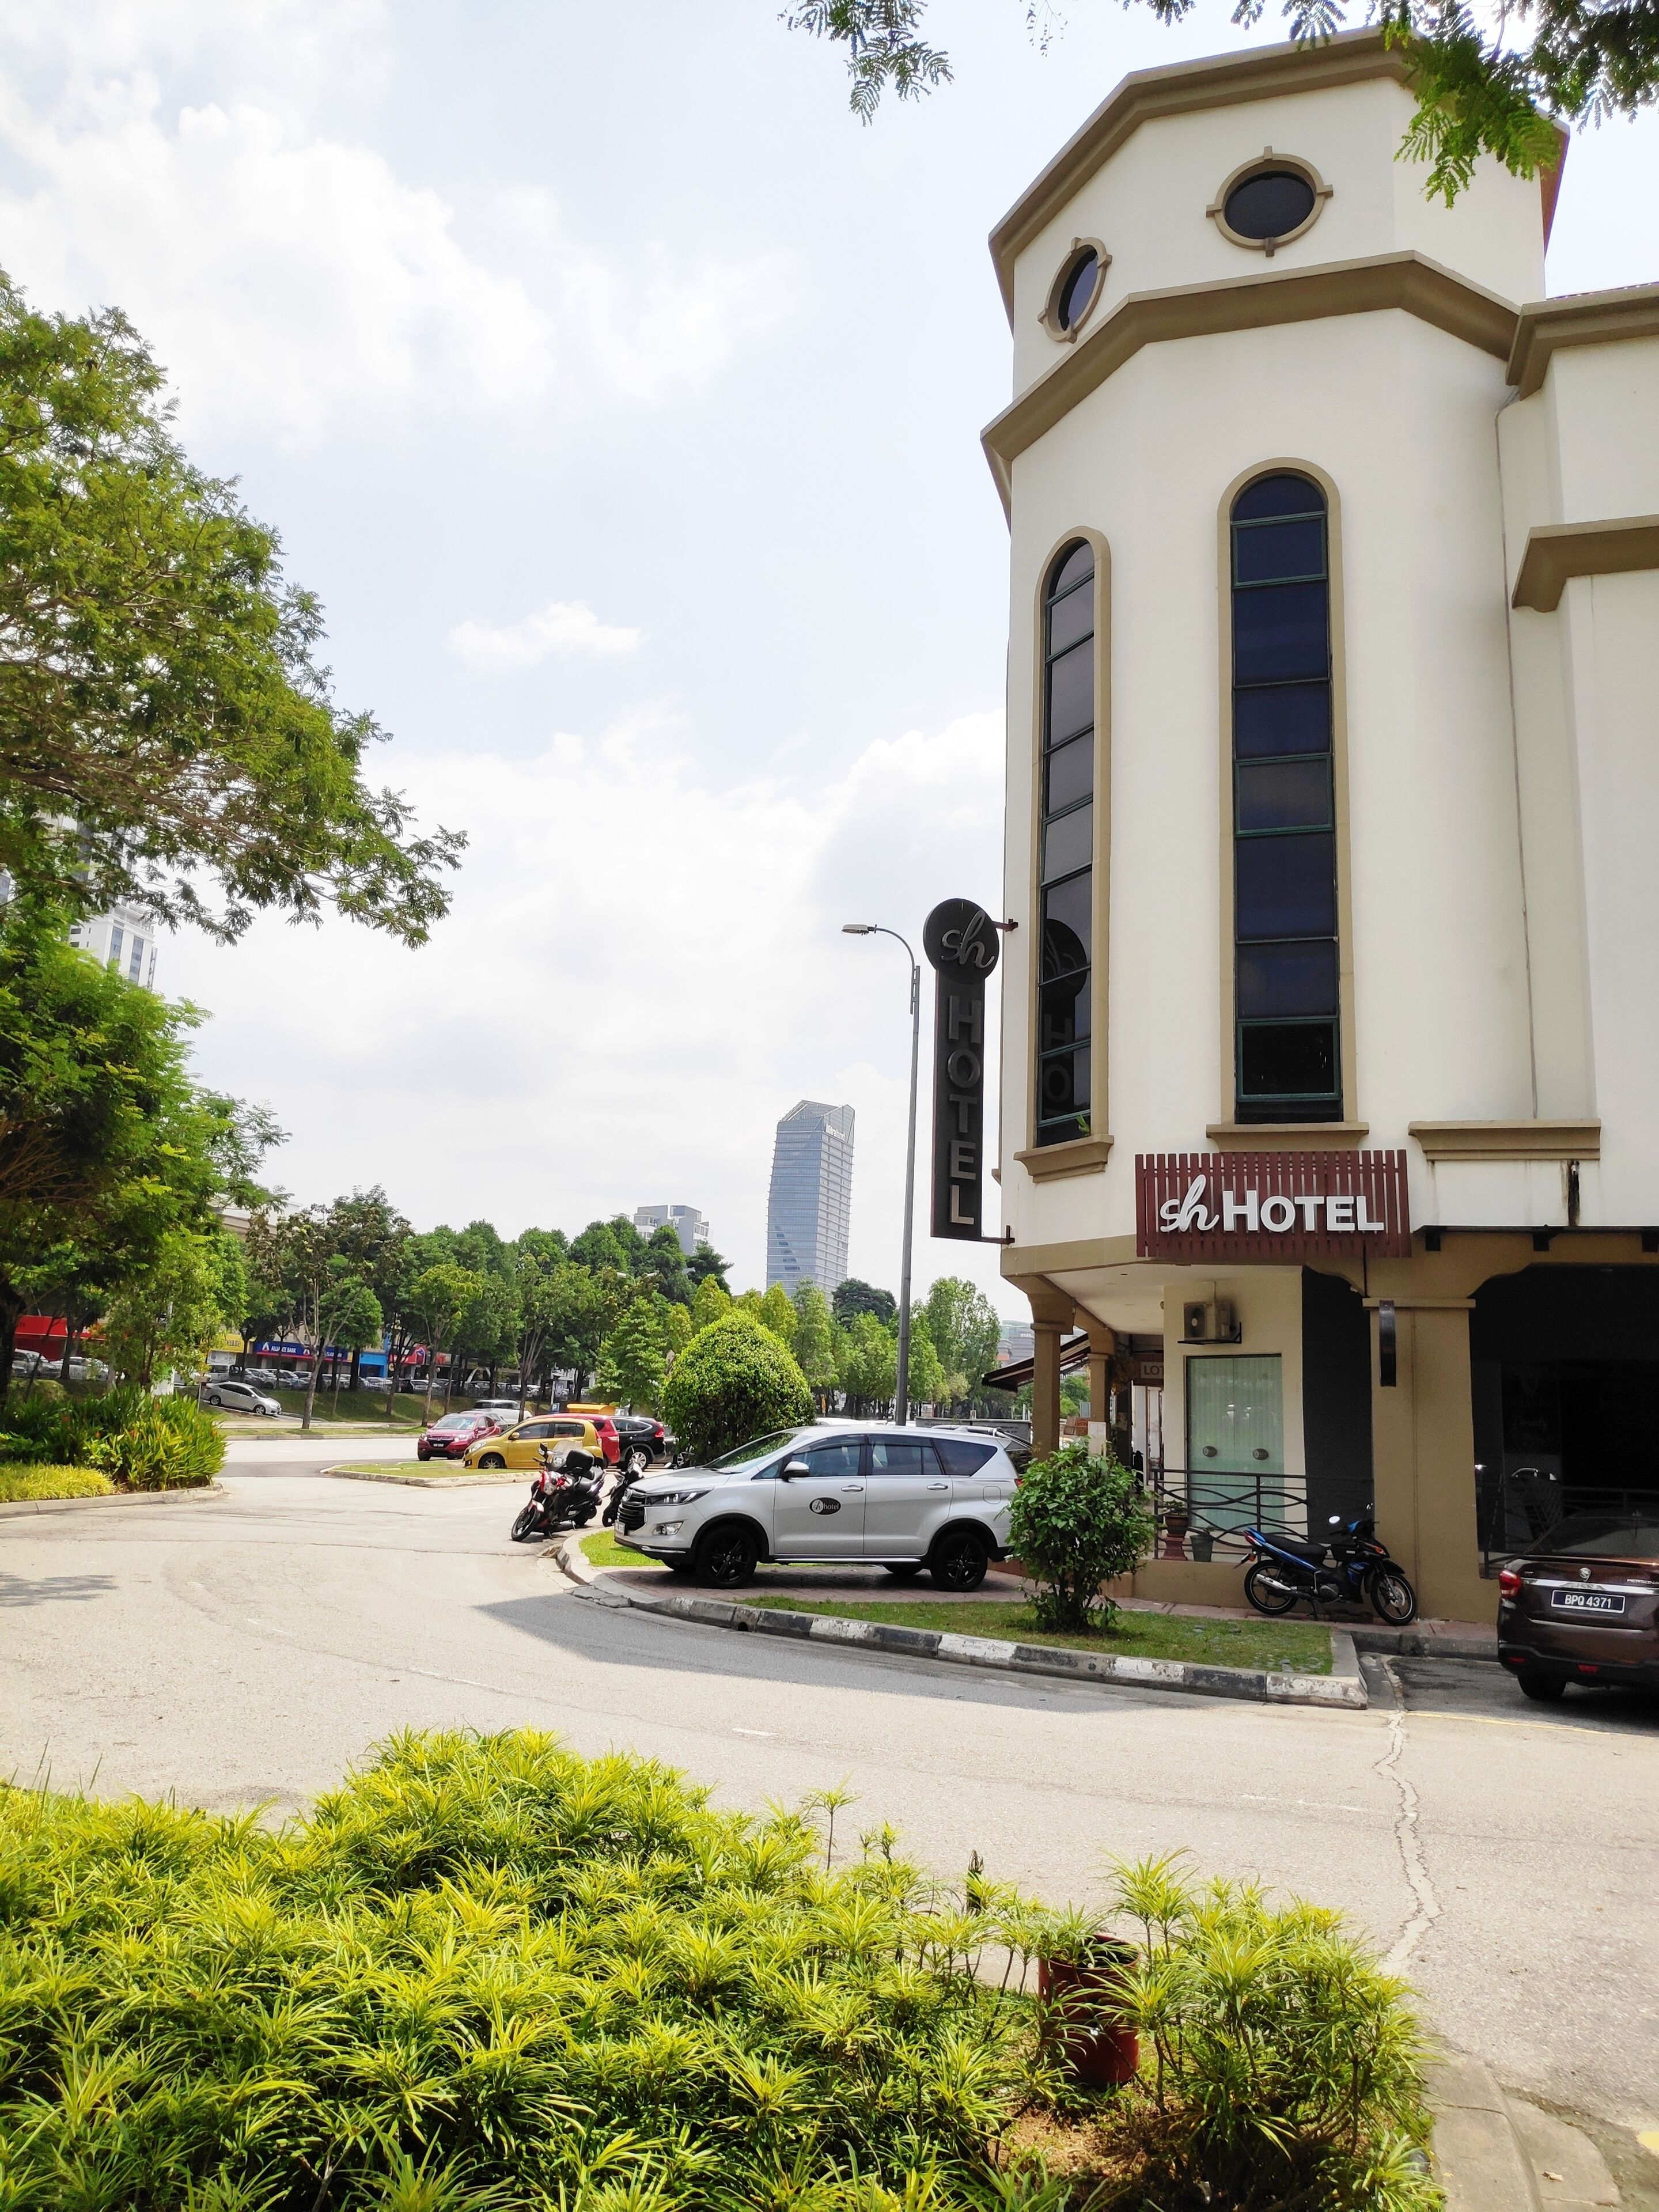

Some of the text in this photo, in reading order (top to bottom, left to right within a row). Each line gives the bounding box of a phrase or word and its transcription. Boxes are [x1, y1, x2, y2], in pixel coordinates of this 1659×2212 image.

[941, 908, 995, 969] sh
[826, 1124, 845, 1141] Mitraland
[948, 995, 982, 1225] HOTEL
[1160, 1174, 1385, 1233] sh HOTEL
[1564, 1594, 1611, 1609] BPQ 4371
